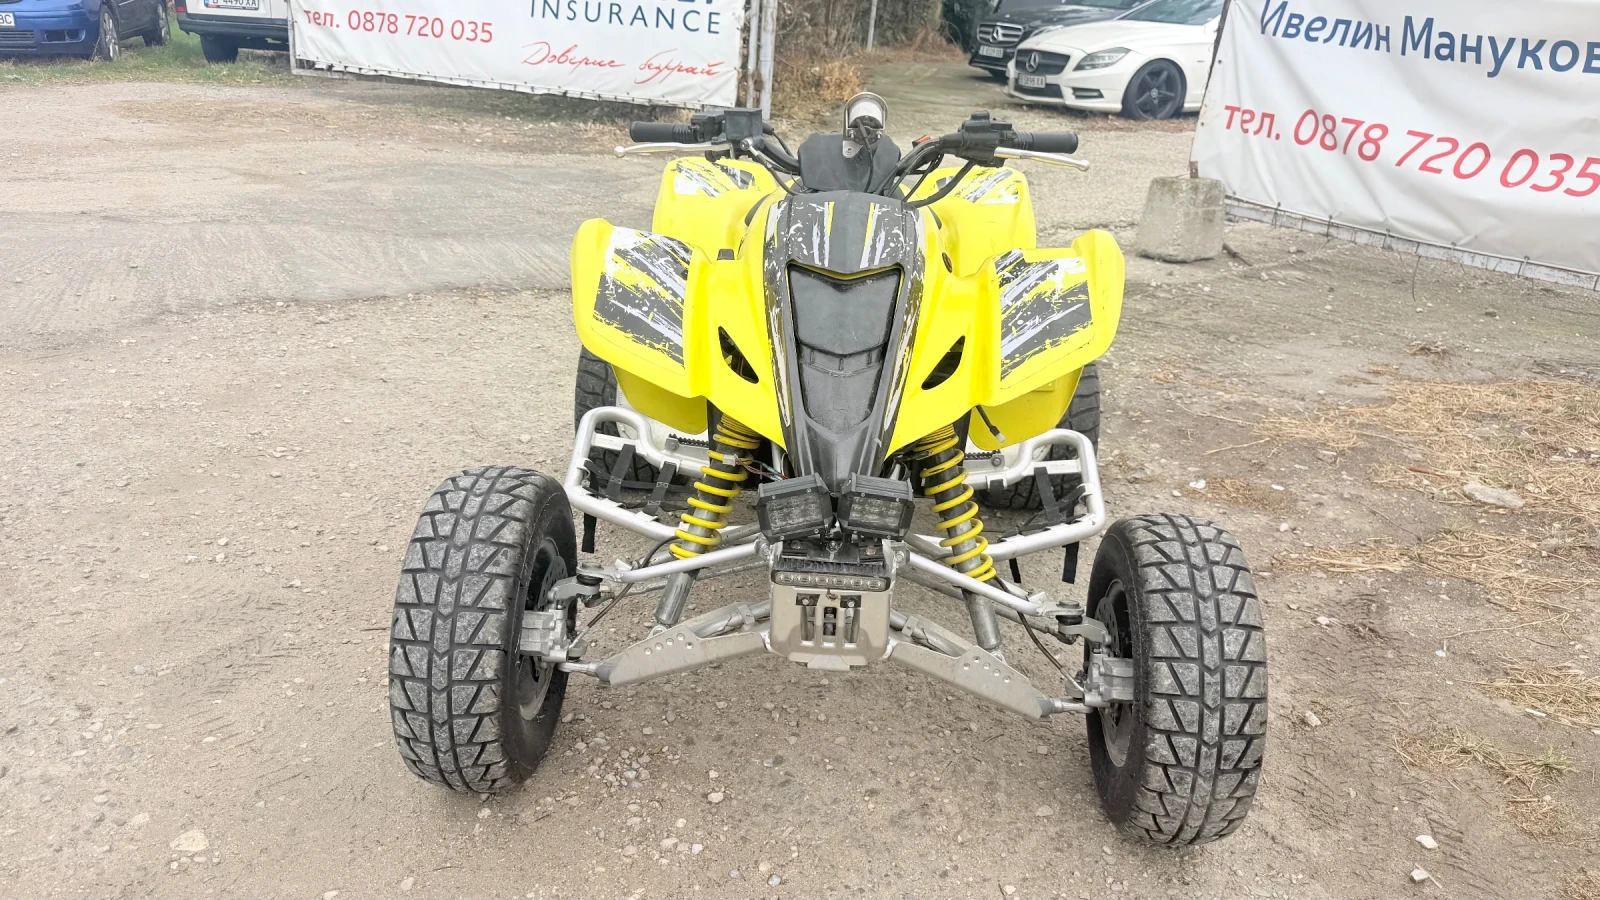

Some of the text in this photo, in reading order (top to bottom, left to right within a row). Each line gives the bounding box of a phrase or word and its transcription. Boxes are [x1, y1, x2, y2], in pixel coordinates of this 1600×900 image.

[303, 10, 493, 43] тел. 0878 720 035
[530, 0, 721, 35] INSURANCE
[1260, 0, 1391, 53] Ивелин
[1223, 105, 1600, 198] тел. 0878 720 035
